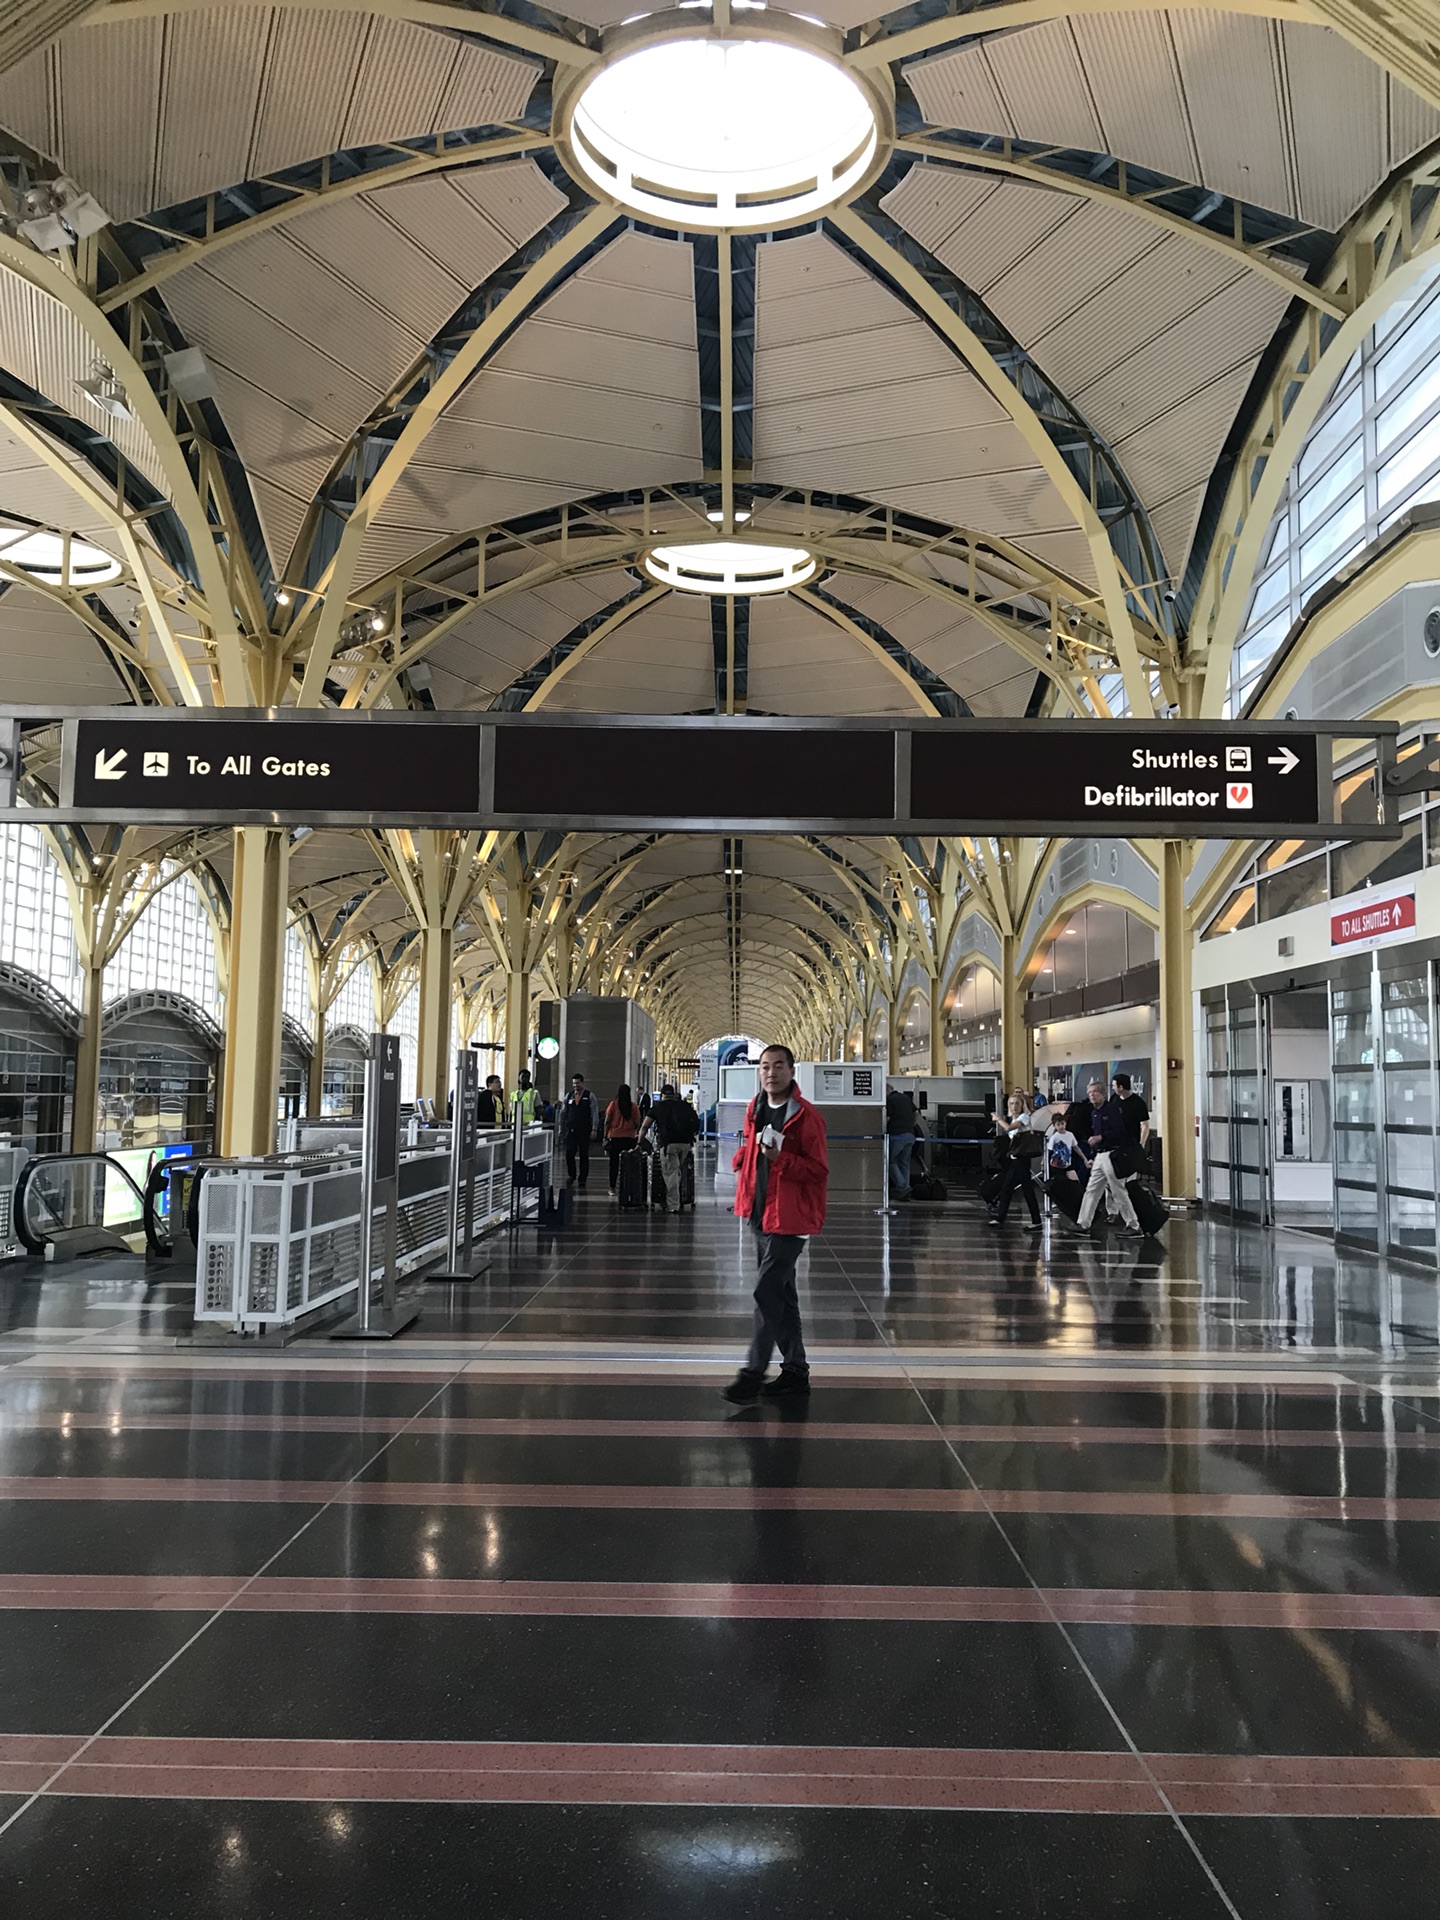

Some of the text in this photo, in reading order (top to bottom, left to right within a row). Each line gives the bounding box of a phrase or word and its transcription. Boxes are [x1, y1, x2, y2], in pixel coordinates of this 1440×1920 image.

[187, 755, 331, 777] To All Gates
[1132, 747, 1219, 770] Shuttles
[1084, 784, 1219, 808] Defibrillator
[1342, 908, 1391, 938] TO ALL SHUTTLES
